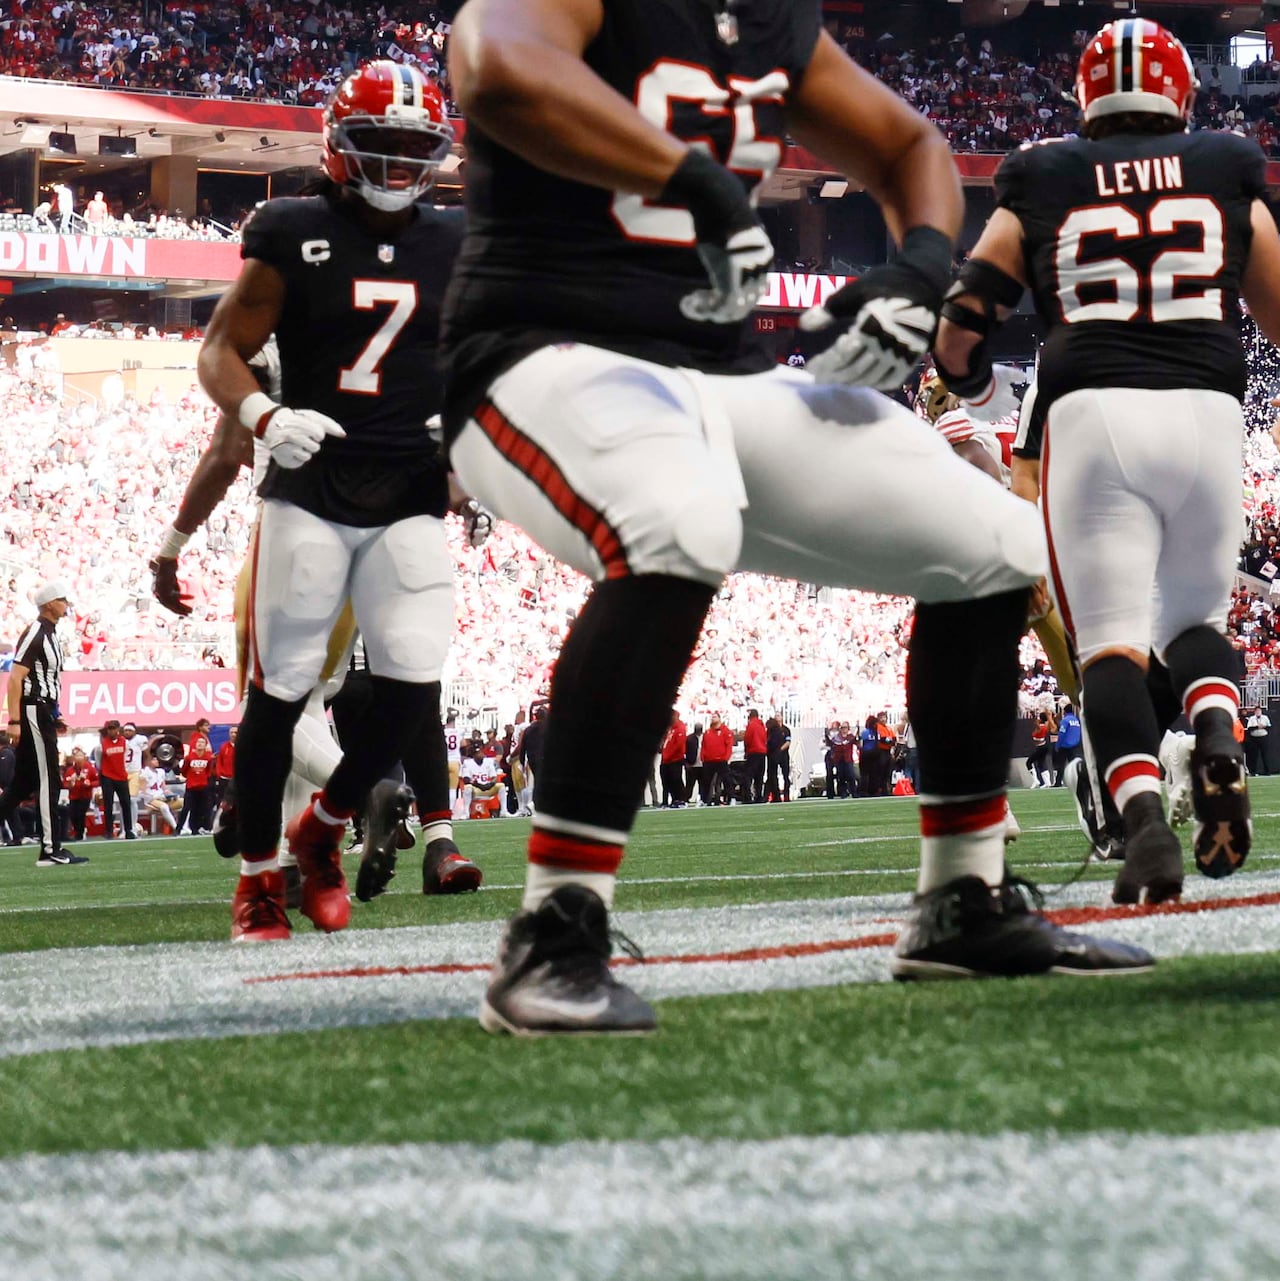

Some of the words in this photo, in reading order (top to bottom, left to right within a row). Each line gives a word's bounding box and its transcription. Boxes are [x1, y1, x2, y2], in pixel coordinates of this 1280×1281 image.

[1094, 155, 1183, 197] LEVIN
[301, 239, 331, 263] C
[1055, 195, 1225, 323] 62
[337, 278, 419, 396] 7
[757, 318, 775, 330] 133
[68, 681, 236, 716] FALCONS
